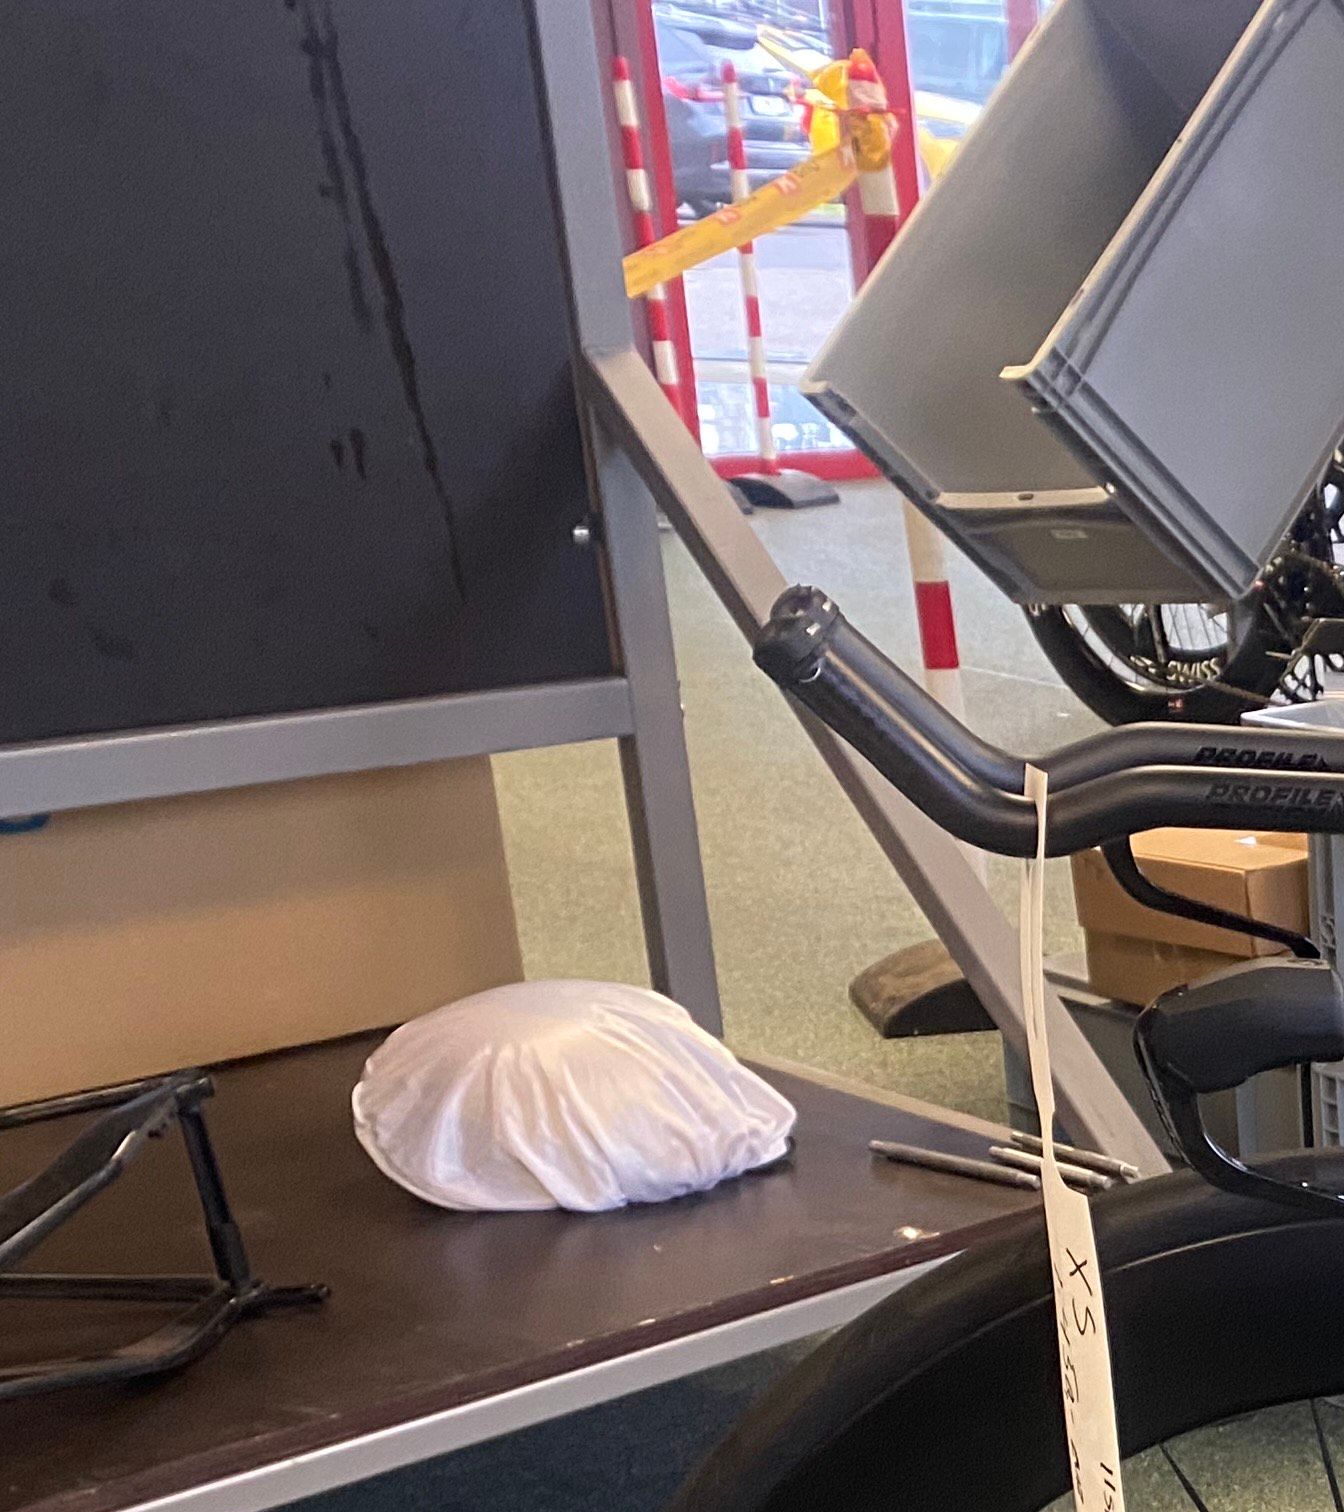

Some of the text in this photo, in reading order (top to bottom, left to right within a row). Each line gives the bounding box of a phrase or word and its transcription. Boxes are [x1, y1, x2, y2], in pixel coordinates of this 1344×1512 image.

[1166, 657, 1221, 683] SWISS
[1206, 782, 1339, 807] PROFILE
[1066, 1248, 1097, 1336] XS
